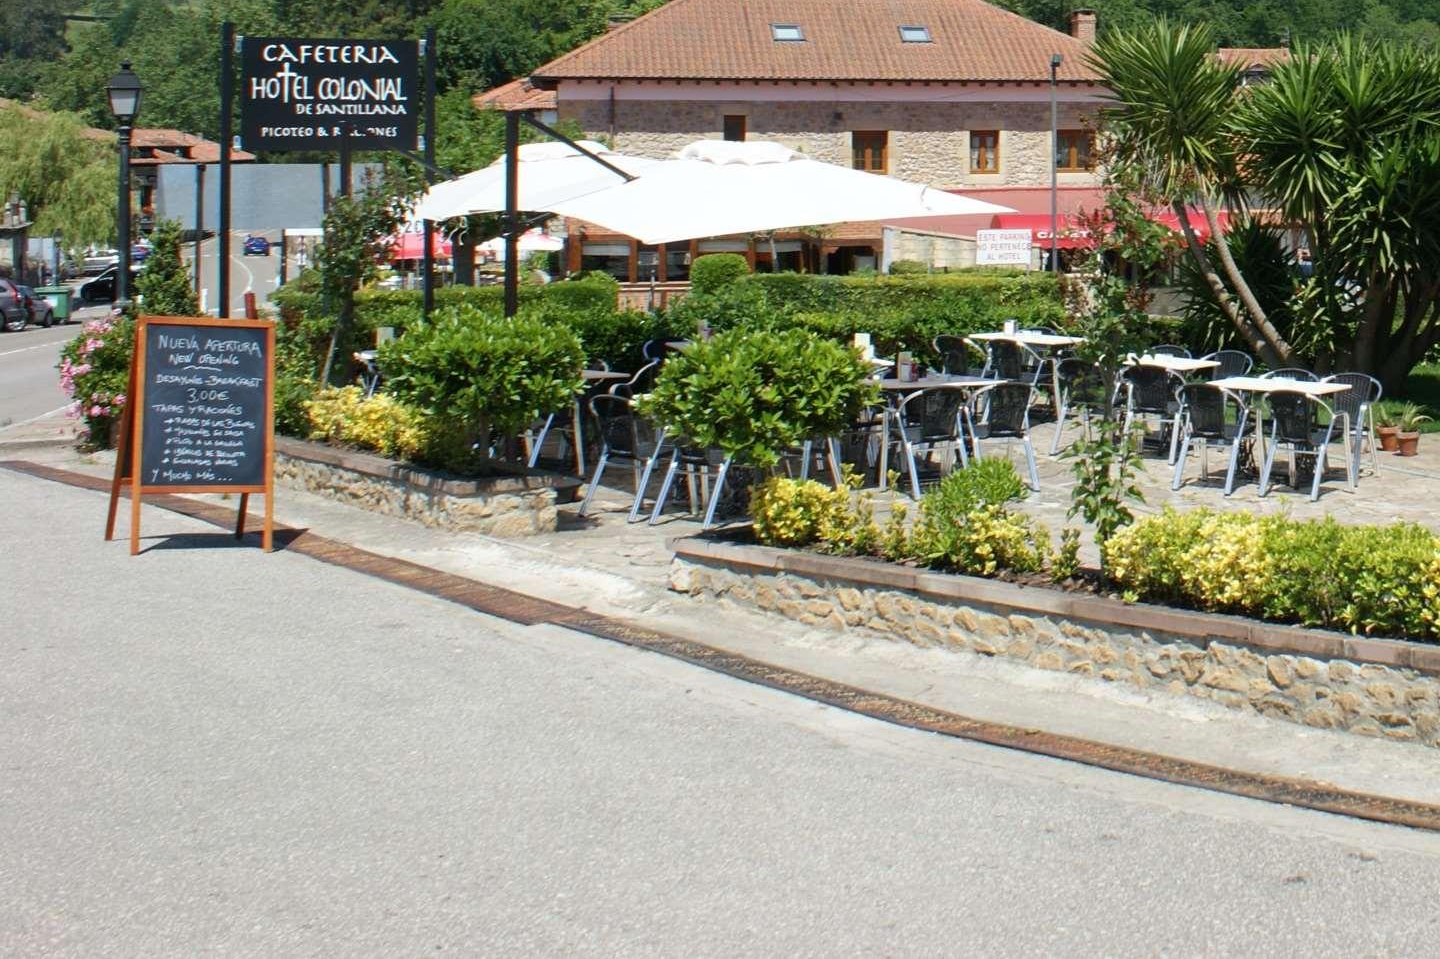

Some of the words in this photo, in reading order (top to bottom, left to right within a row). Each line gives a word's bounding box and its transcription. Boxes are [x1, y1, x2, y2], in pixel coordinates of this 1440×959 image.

[263, 44, 399, 63] CAFETERIA
[251, 62, 314, 103] HOTEL
[318, 77, 408, 100] COLONIAL
[295, 103, 312, 115] DE
[315, 103, 407, 115] SANTILLANA
[261, 126, 313, 137] PICOTEO
[317, 126, 328, 137] &
[979, 233, 996, 242] ESTE
[999, 233, 1031, 242] PARKING
[991, 242, 1032, 250] PERTENECE
[987, 252, 996, 261] AL
[998, 252, 1021, 261] HOTEL
[158, 334, 200, 351] NUEVA
[204, 339, 262, 357] APERTURA
[168, 352, 195, 364] NEW
[199, 353, 239, 364] OPENING
[152, 404, 185, 414] TAPAS
